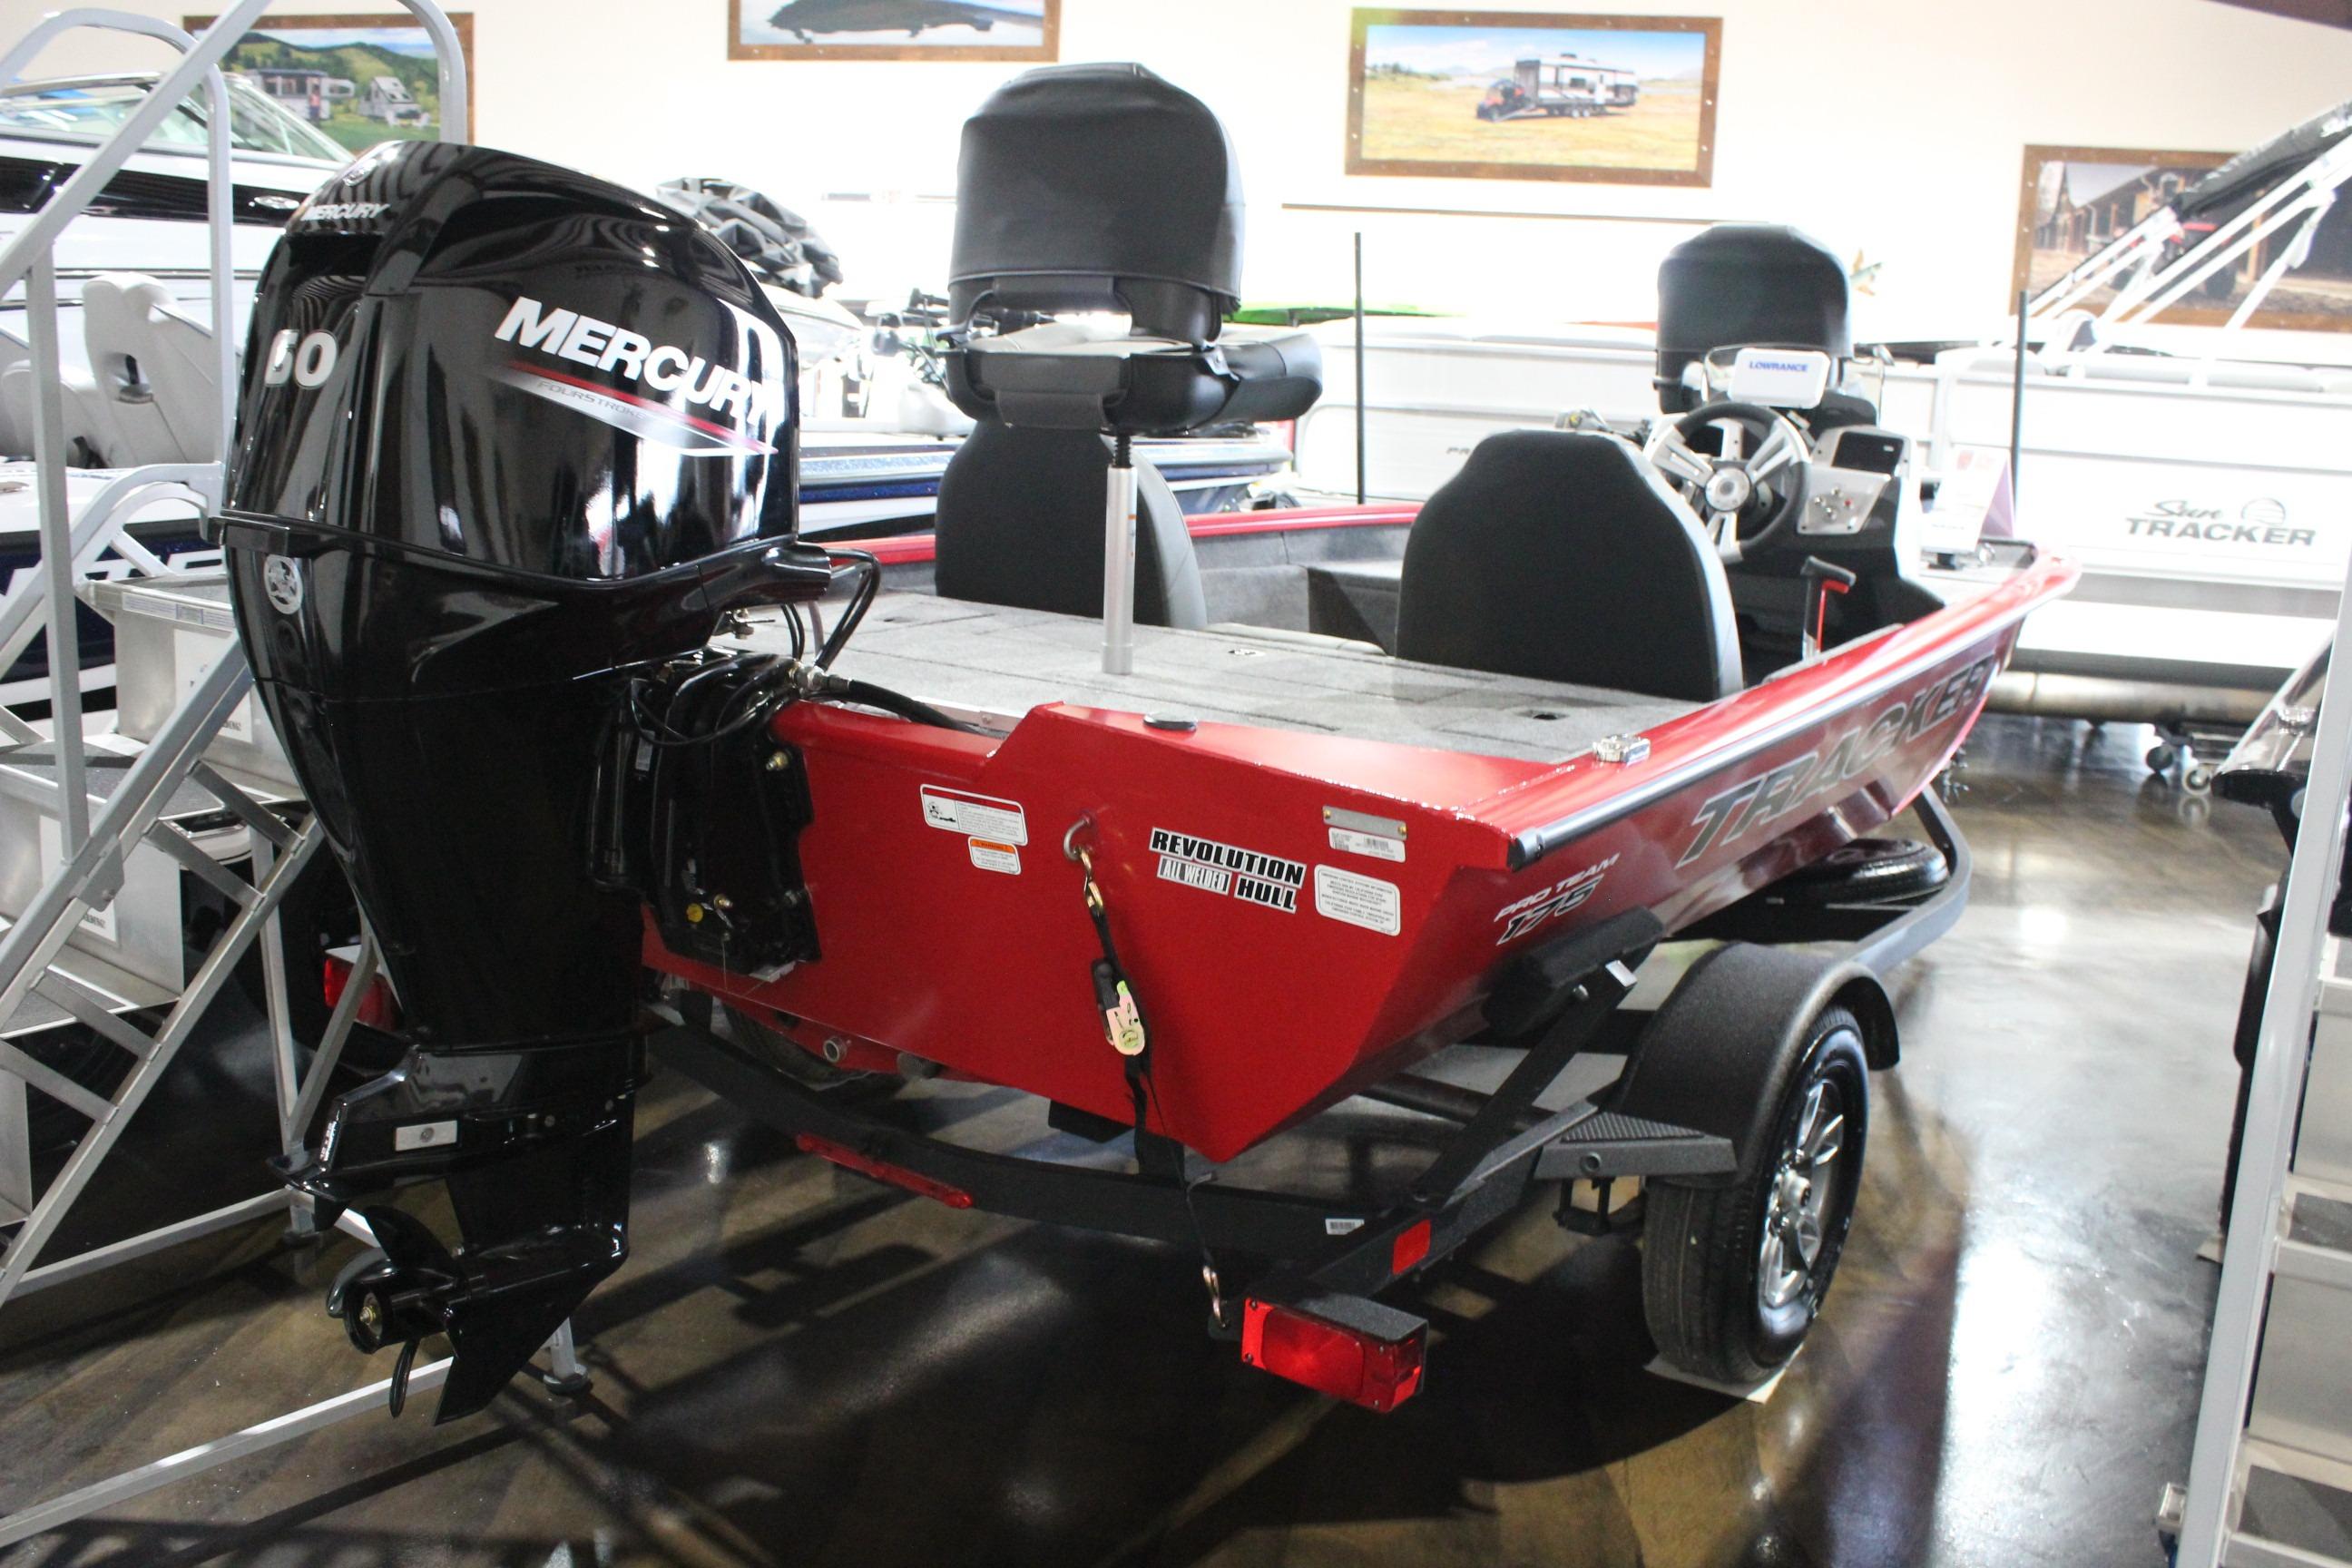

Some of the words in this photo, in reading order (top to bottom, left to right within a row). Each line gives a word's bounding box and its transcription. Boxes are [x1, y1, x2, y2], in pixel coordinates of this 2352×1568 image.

[300, 201, 391, 221] MERCURY
[495, 296, 782, 427] MERCURY
[1749, 360, 1808, 373] LOWRANCE
[537, 380, 647, 420] FOURSTROKE
[2125, 517, 2317, 546] TRACKER
[2143, 499, 2222, 520] Sun
[1675, 650, 1994, 869] TRACKER
[1152, 829, 1304, 886] REVOLUTION
[1162, 858, 1184, 882] ALL
[1183, 863, 1226, 893] WELDED
[1237, 877, 1295, 910] HULL
[1494, 887, 1553, 923] PRO
[1555, 851, 1621, 893] TEAM
[1495, 873, 1605, 946] 175
